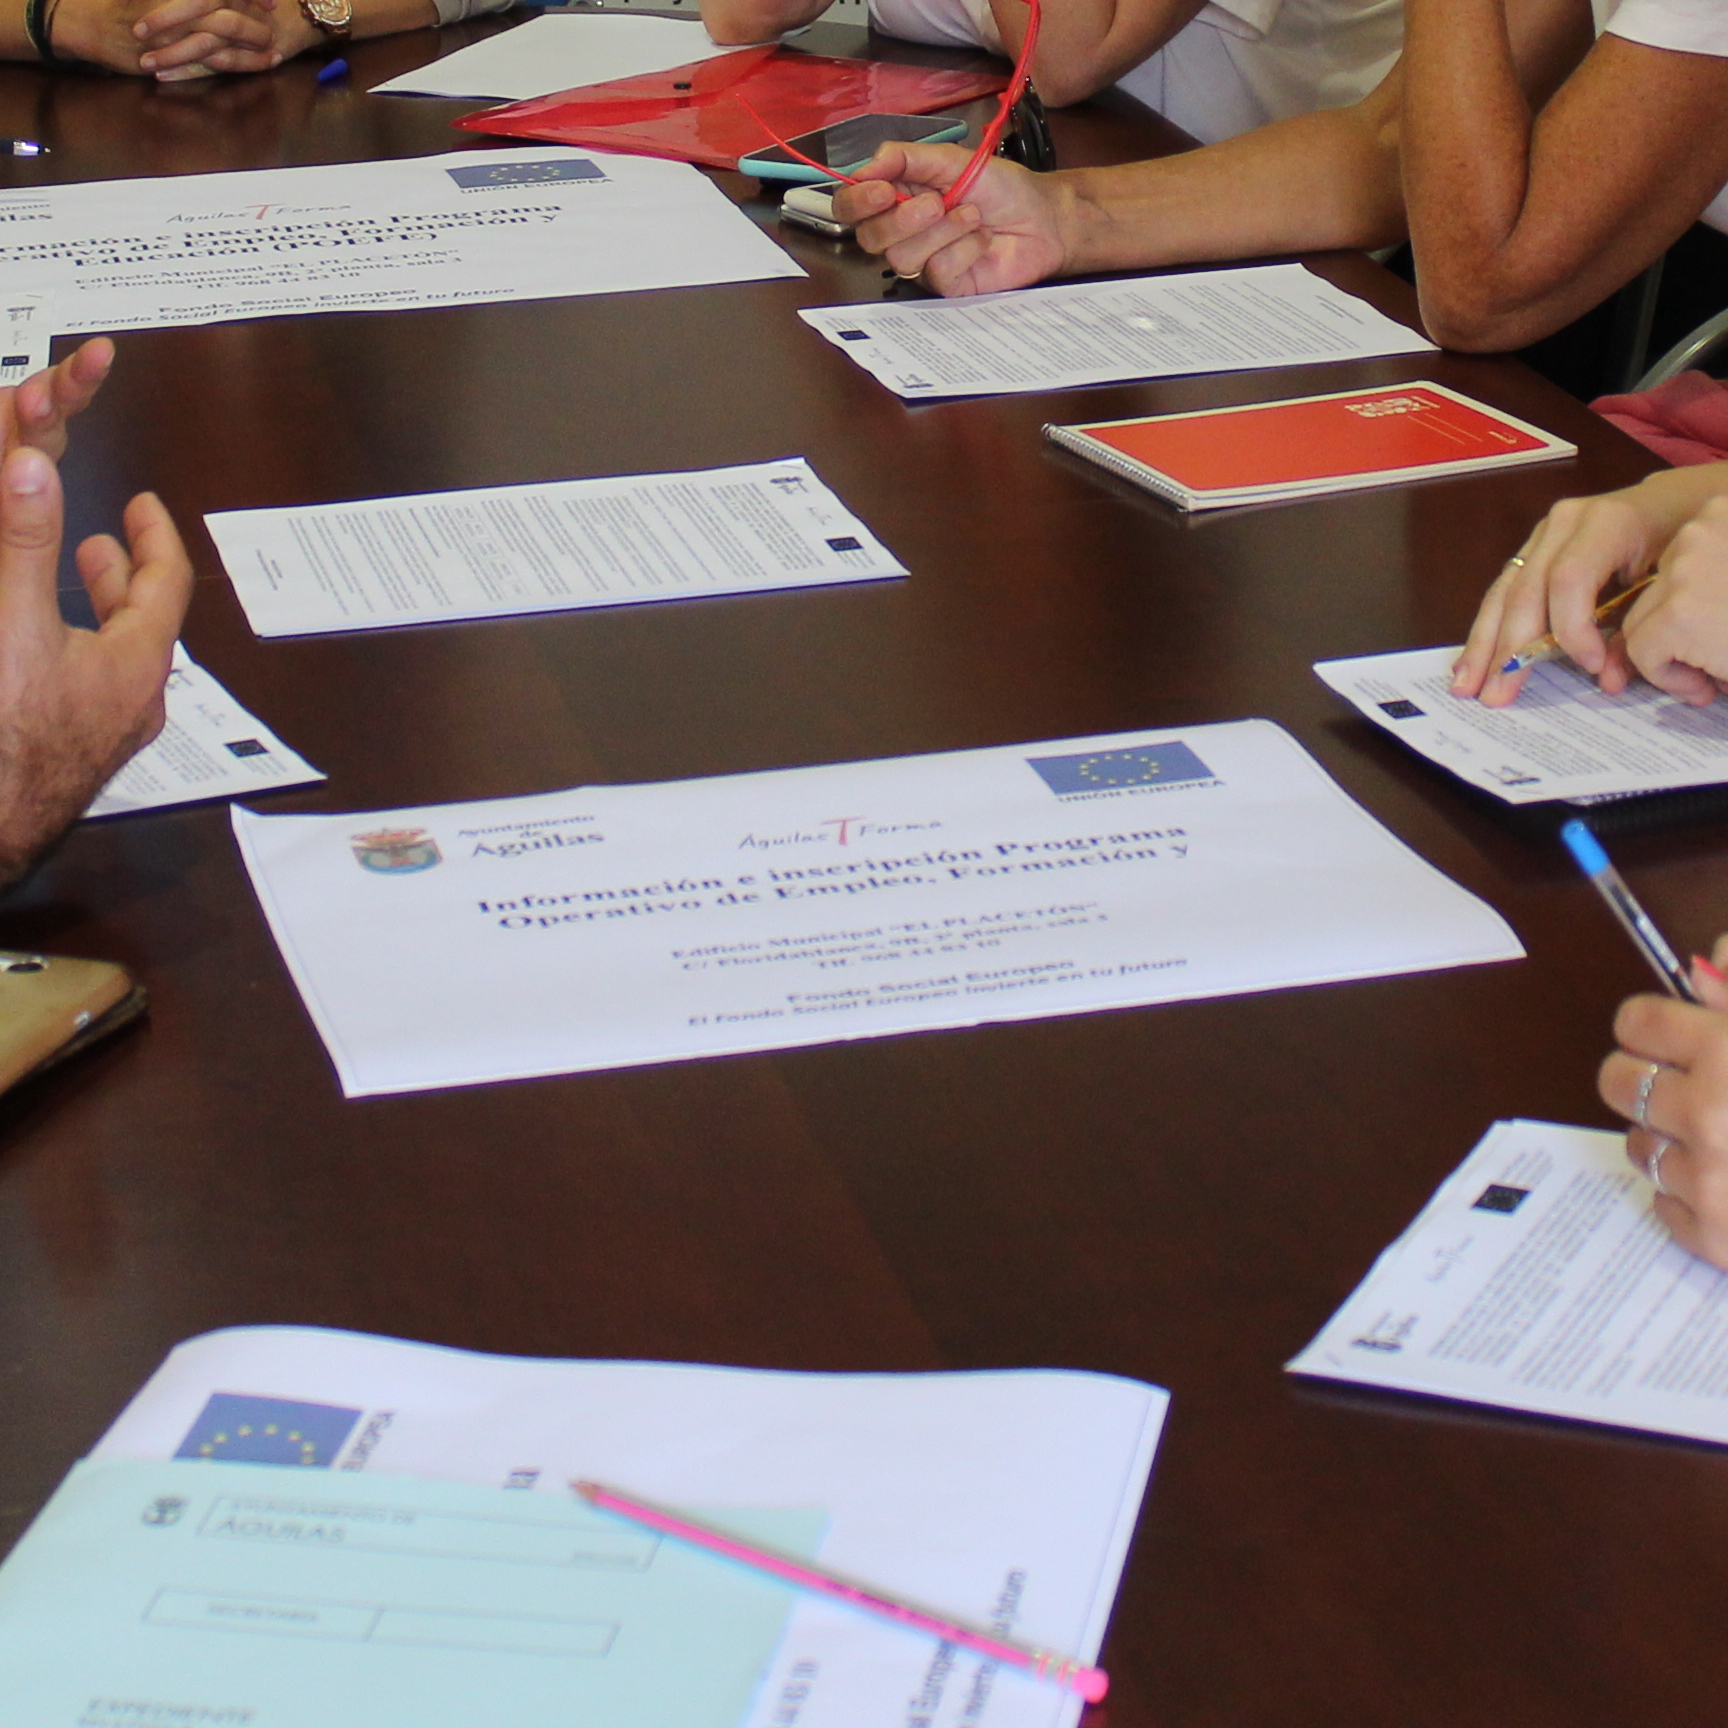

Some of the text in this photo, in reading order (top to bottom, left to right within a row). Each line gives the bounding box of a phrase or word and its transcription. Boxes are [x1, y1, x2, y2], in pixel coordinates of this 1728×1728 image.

[129, 240, 170, 252] de
[339, 216, 529, 237] Formación
[539, 214, 560, 223] y
[183, 215, 376, 239] inscripción
[388, 205, 564, 224] Programa
[74, 232, 440, 266] Educación (POEFE)
[158, 303, 233, 313] Fondo
[318, 289, 417, 301] Europeo
[478, 826, 1188, 914] Información e inscripción Programa
[498, 899, 702, 930] Operativo
[715, 891, 761, 907] de
[947, 847, 1158, 881] Formación
[1169, 843, 1190, 859] y
[785, 959, 1075, 1003] Fondo Social Europeo
